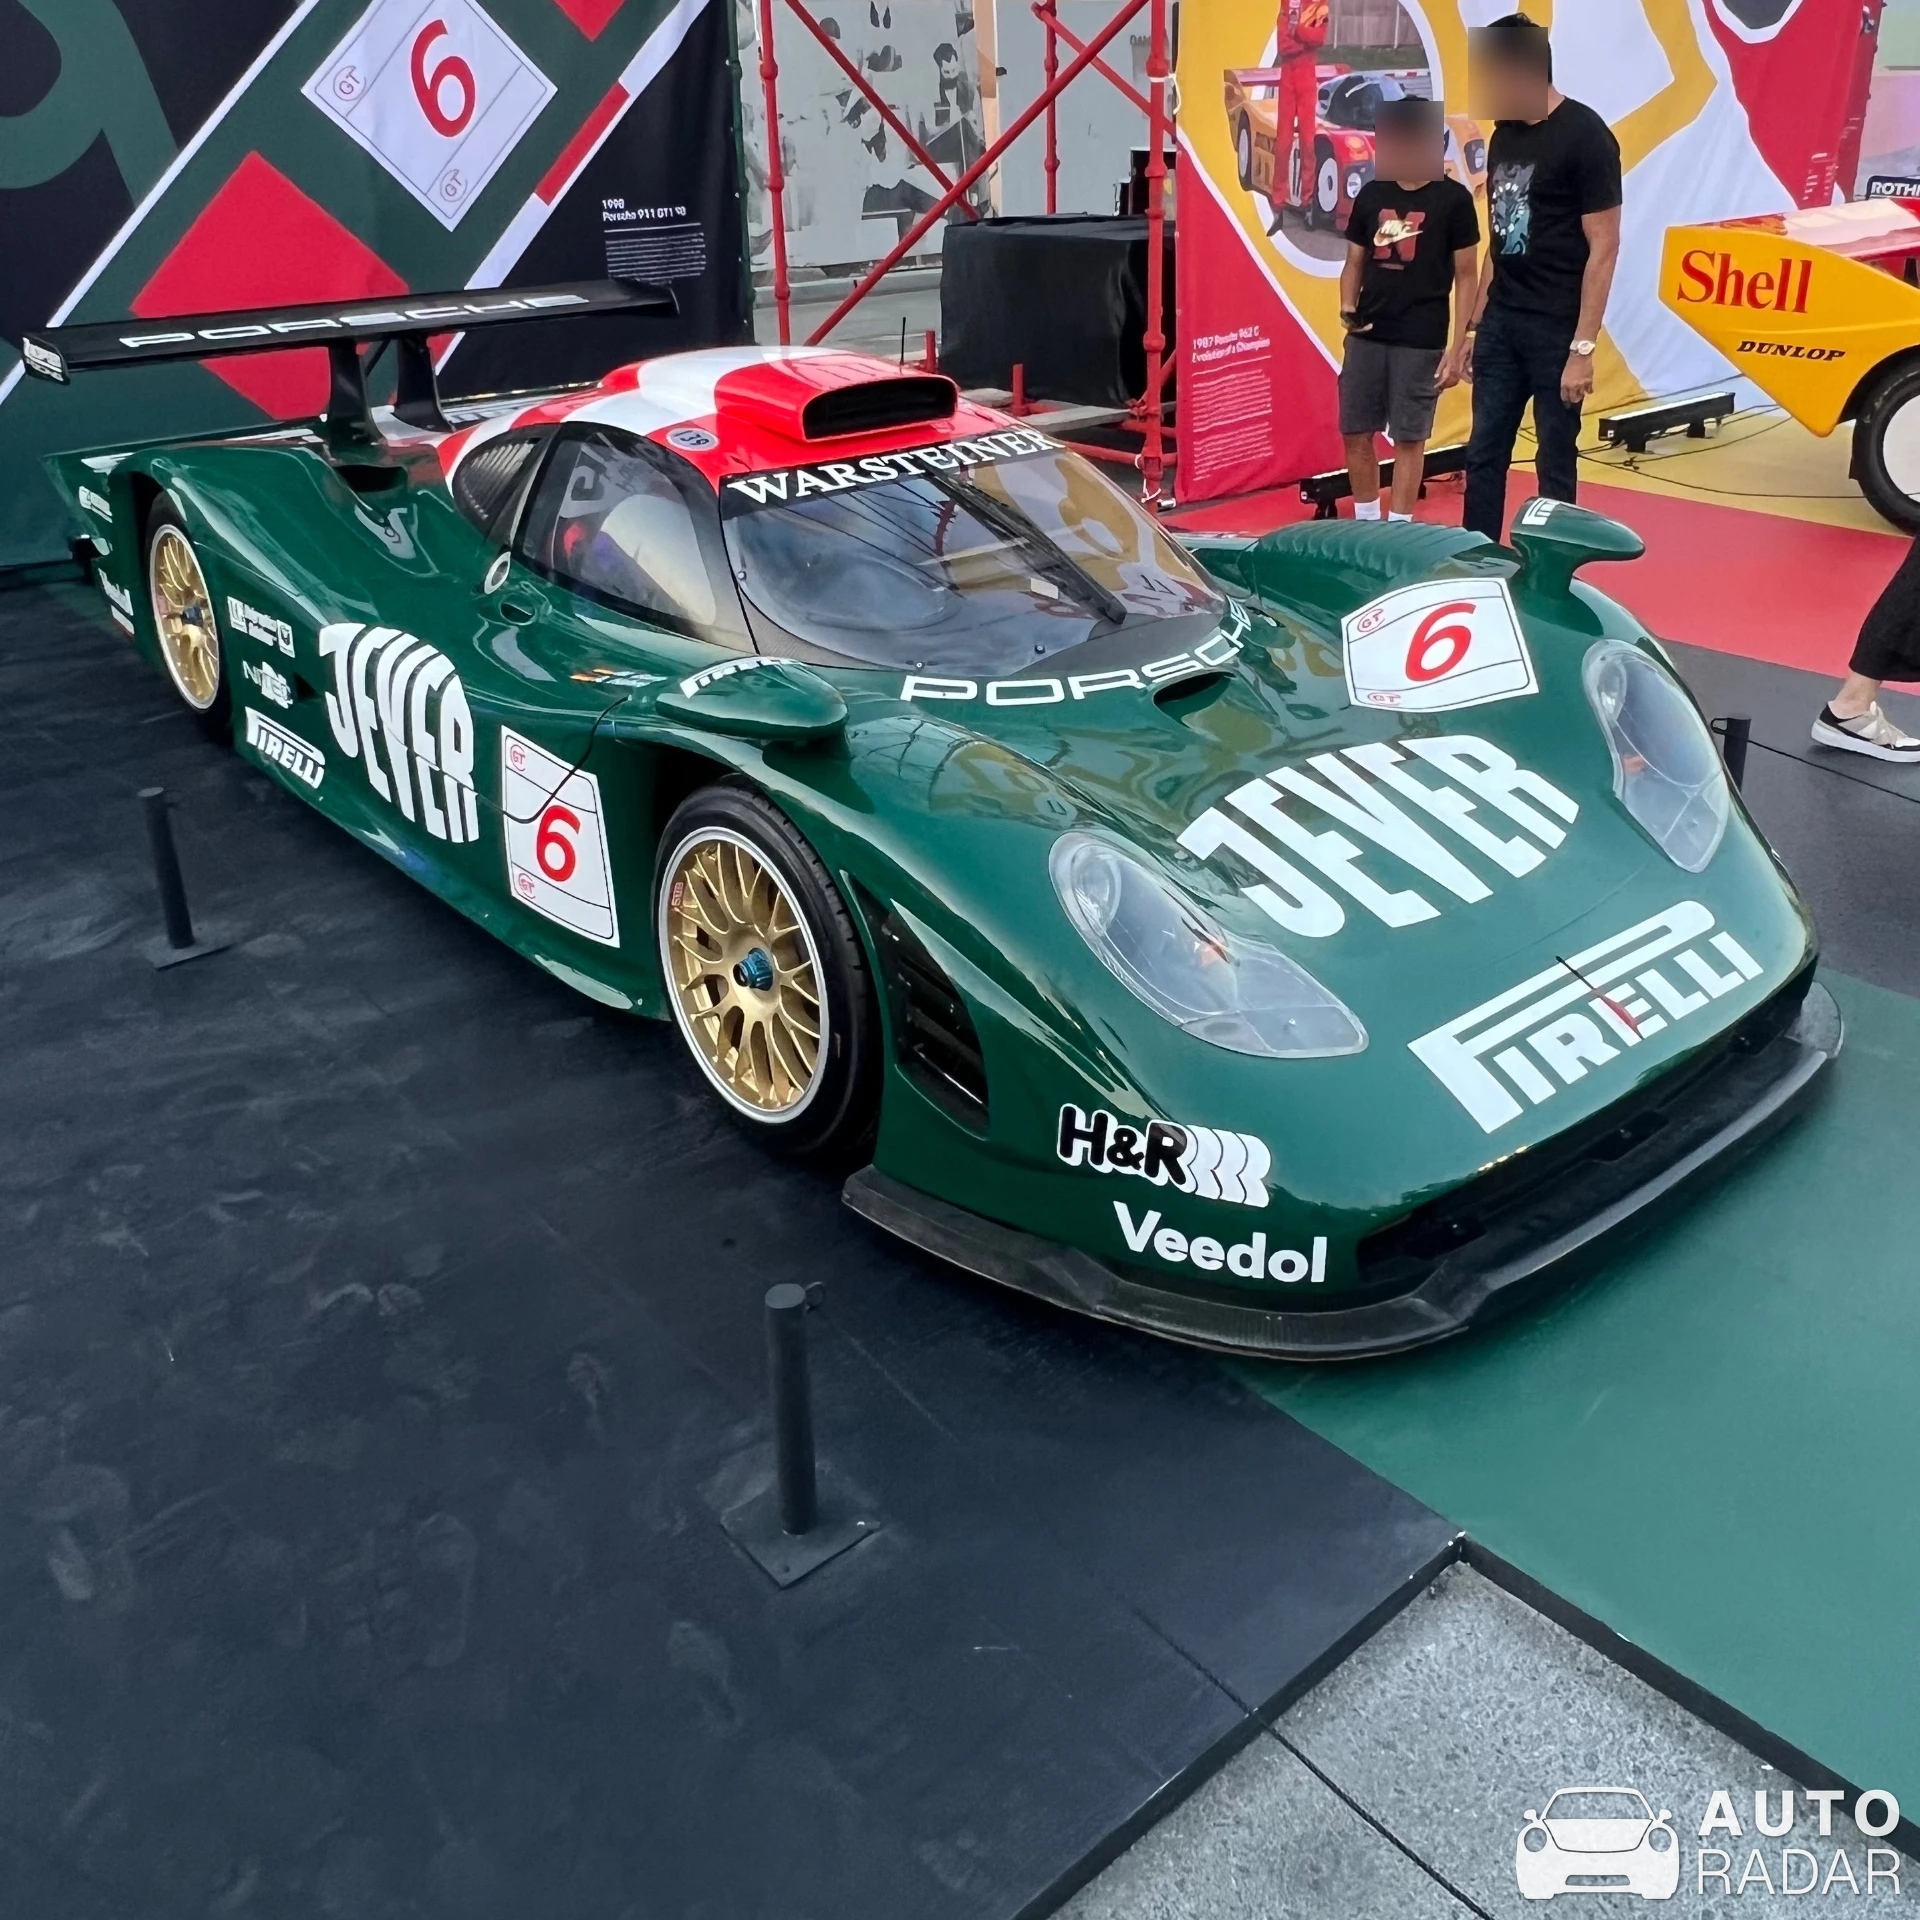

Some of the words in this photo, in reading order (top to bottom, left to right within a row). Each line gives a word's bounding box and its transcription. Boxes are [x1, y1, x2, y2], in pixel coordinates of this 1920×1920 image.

[411, 19, 476, 138] 6
[602, 198, 625, 210] 1998
[637, 208, 655, 219] 911
[657, 207, 673, 219] GT1
[1870, 181, 1920, 197] ROTH
[119, 294, 590, 348] PORSCHE
[1677, 250, 1813, 314] Shell
[1736, 340, 1846, 361] DUNLOP
[727, 431, 1068, 504] WARSTEINER
[900, 594, 1252, 706] PORSCHE
[1361, 611, 1383, 630] GT
[1405, 602, 1477, 682] 6
[245, 706, 325, 789] PIRELLI
[319, 622, 480, 843] JEVER
[536, 805, 581, 882] 6
[1176, 734, 1580, 938] JEVER
[1407, 900, 1764, 1134] PIRELLI
[1058, 1104, 1190, 1188] H&R
[1113, 1200, 1328, 1283] Veedol
